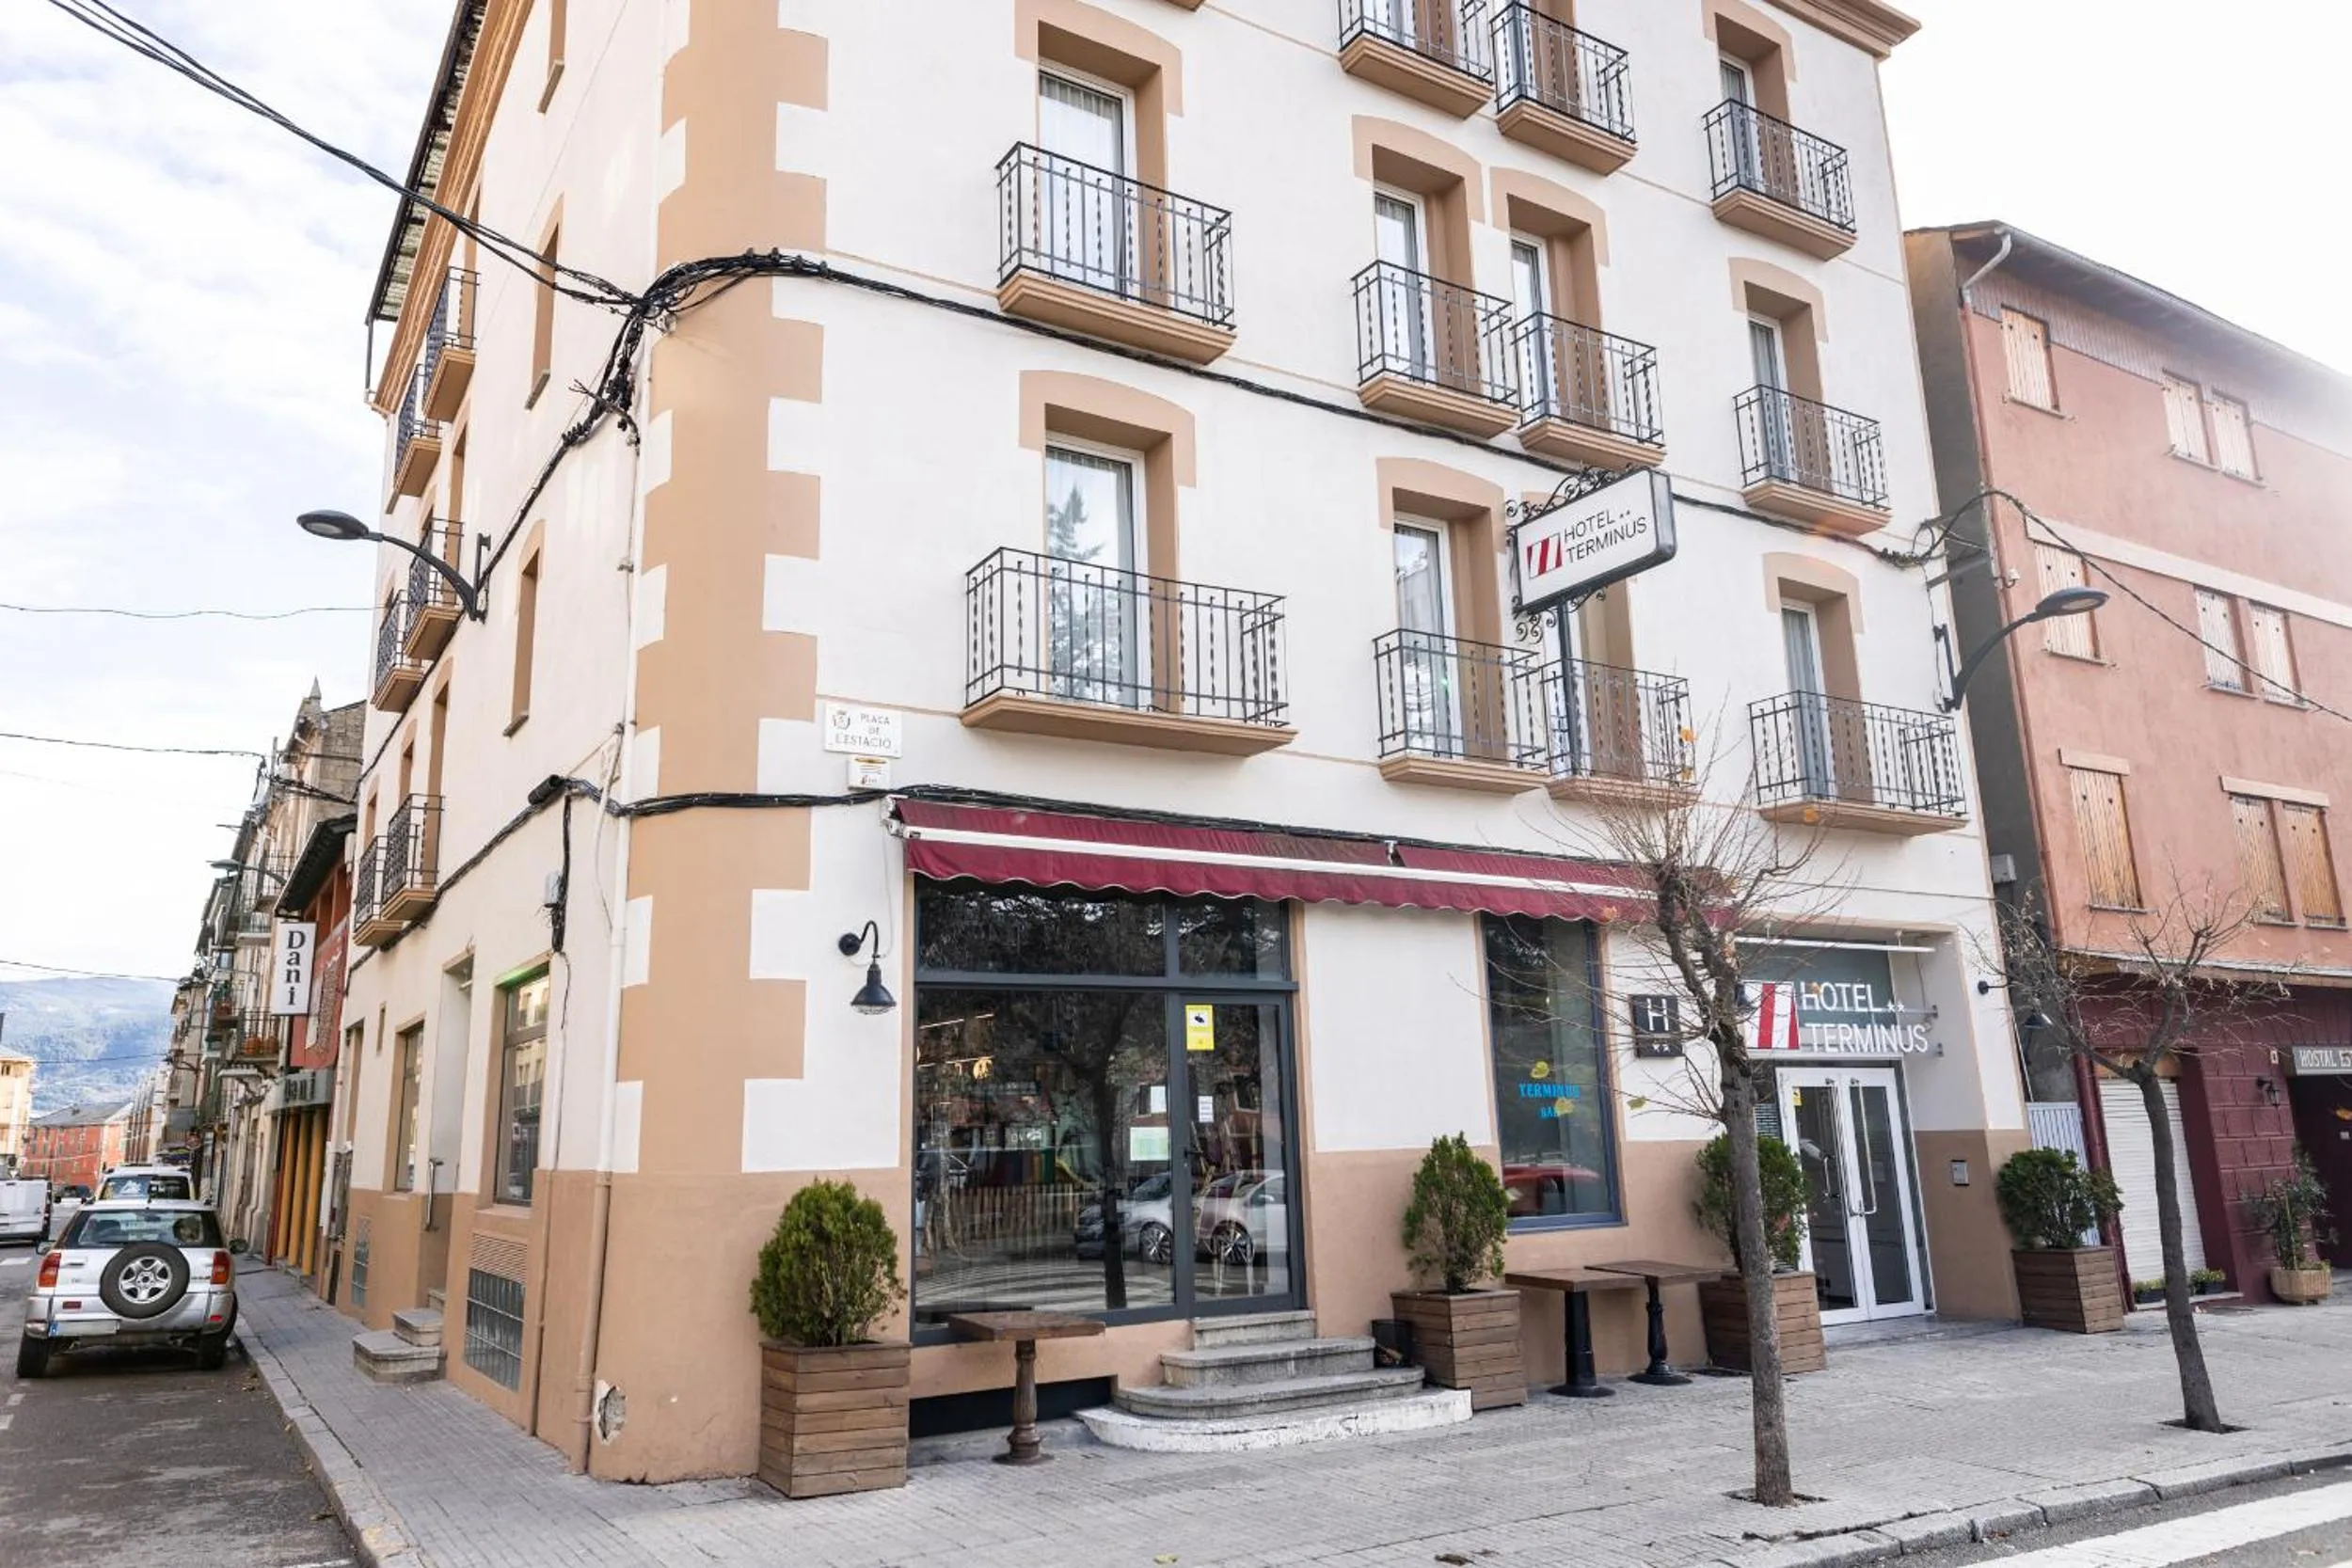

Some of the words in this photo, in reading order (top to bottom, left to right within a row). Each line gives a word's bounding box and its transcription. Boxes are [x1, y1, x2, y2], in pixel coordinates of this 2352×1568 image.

[1564, 509, 1615, 543] HOTEL
[1565, 516, 1647, 563] TERMINUS
[285, 930, 307, 1006] Dani
[1800, 981, 1883, 1012] HOTEL
[1804, 1022, 1929, 1053] TERMINUS
[2298, 1049, 2337, 1067] HOSTAL
[1518, 1082, 1581, 1099] TERMINUS
